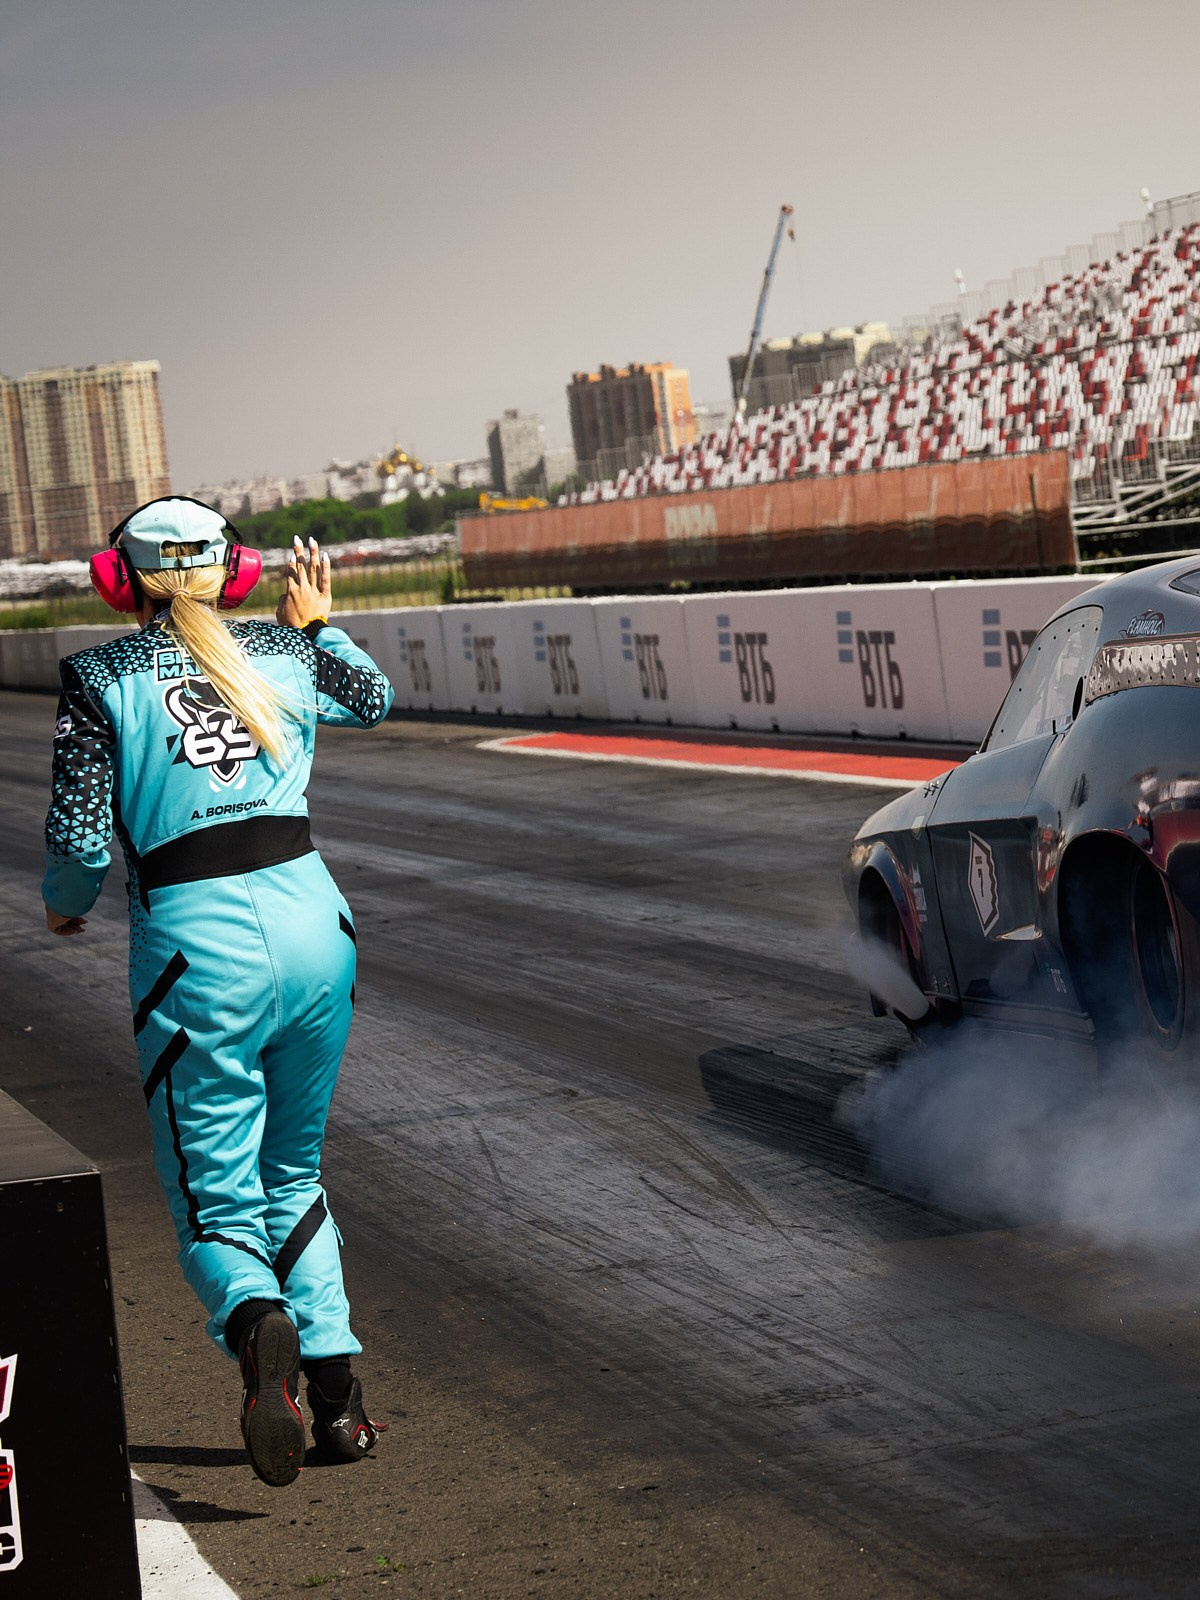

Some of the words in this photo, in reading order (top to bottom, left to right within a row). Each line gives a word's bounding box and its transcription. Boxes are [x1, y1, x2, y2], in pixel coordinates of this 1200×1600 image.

[635, 633, 668, 700] ВТБ
[734, 632, 776, 704] ВТБ
[856, 630, 904, 710] ВТБ
[190, 810, 204, 821] A.
[206, 798, 268, 818] BORISOVA
